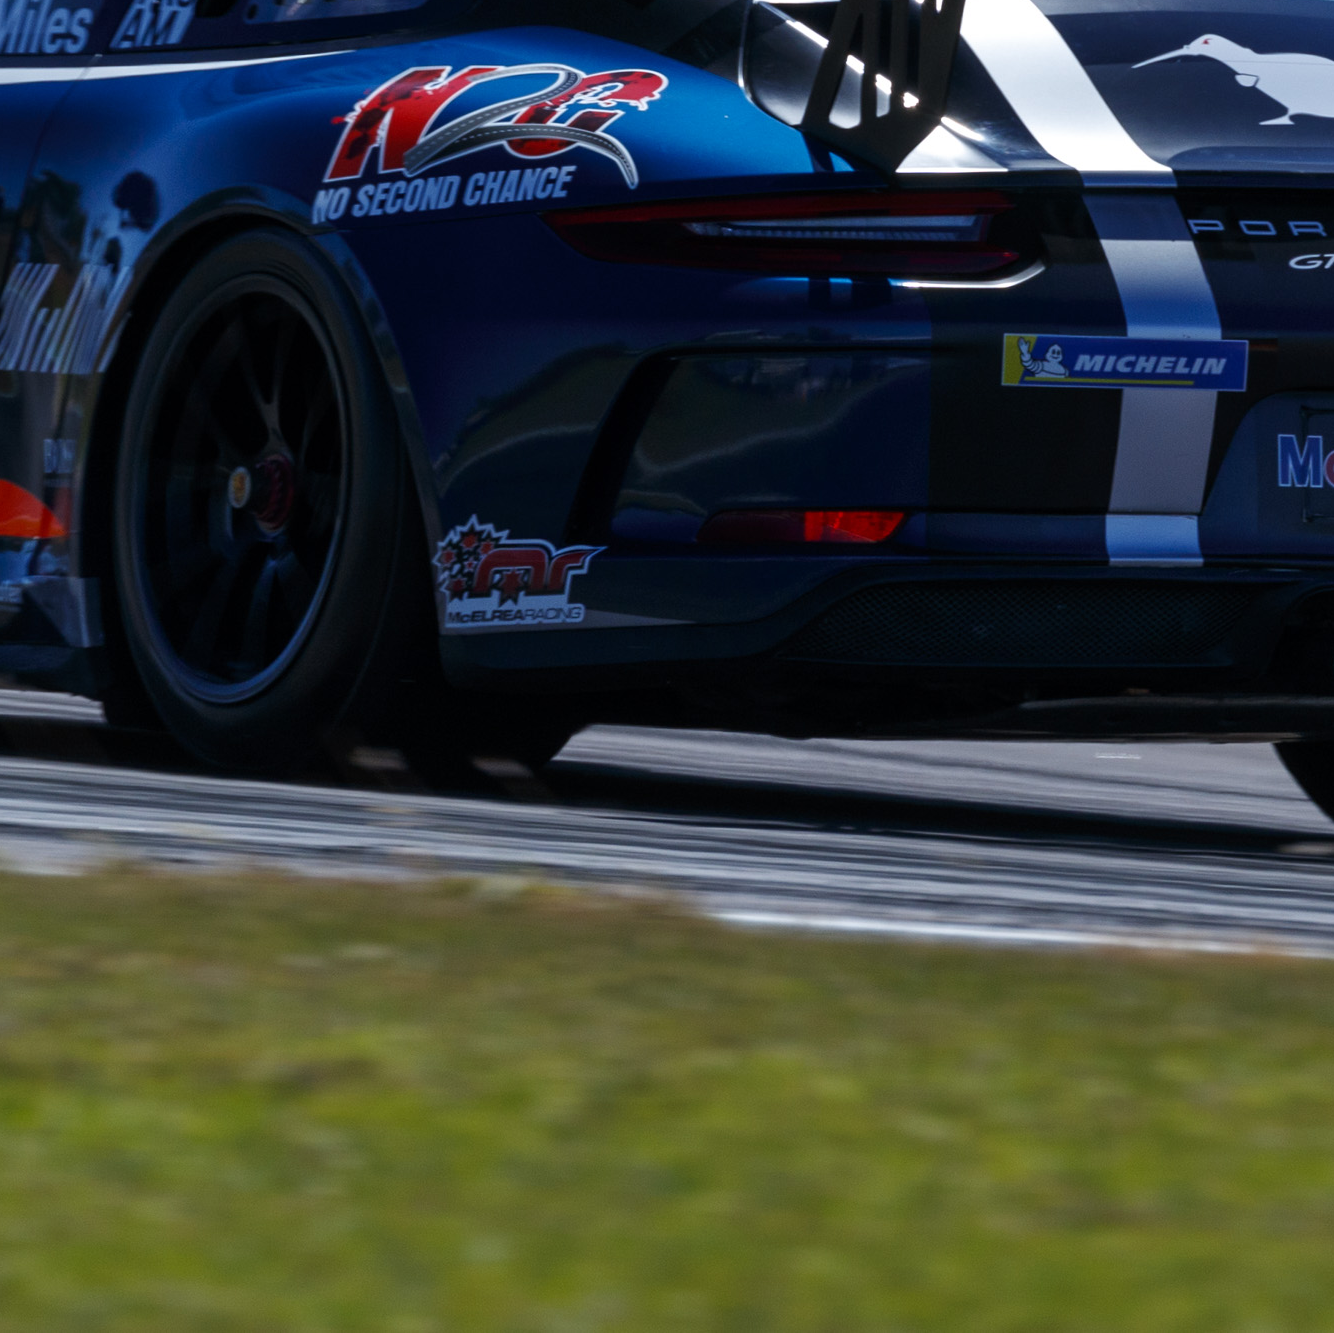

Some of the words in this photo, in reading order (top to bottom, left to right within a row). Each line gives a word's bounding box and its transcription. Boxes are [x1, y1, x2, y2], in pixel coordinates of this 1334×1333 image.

[312, 186, 350, 225] NO
[352, 172, 460, 217] SECOND
[462, 165, 578, 207] CHANCE
[1072, 353, 1228, 376] MICHELIN
